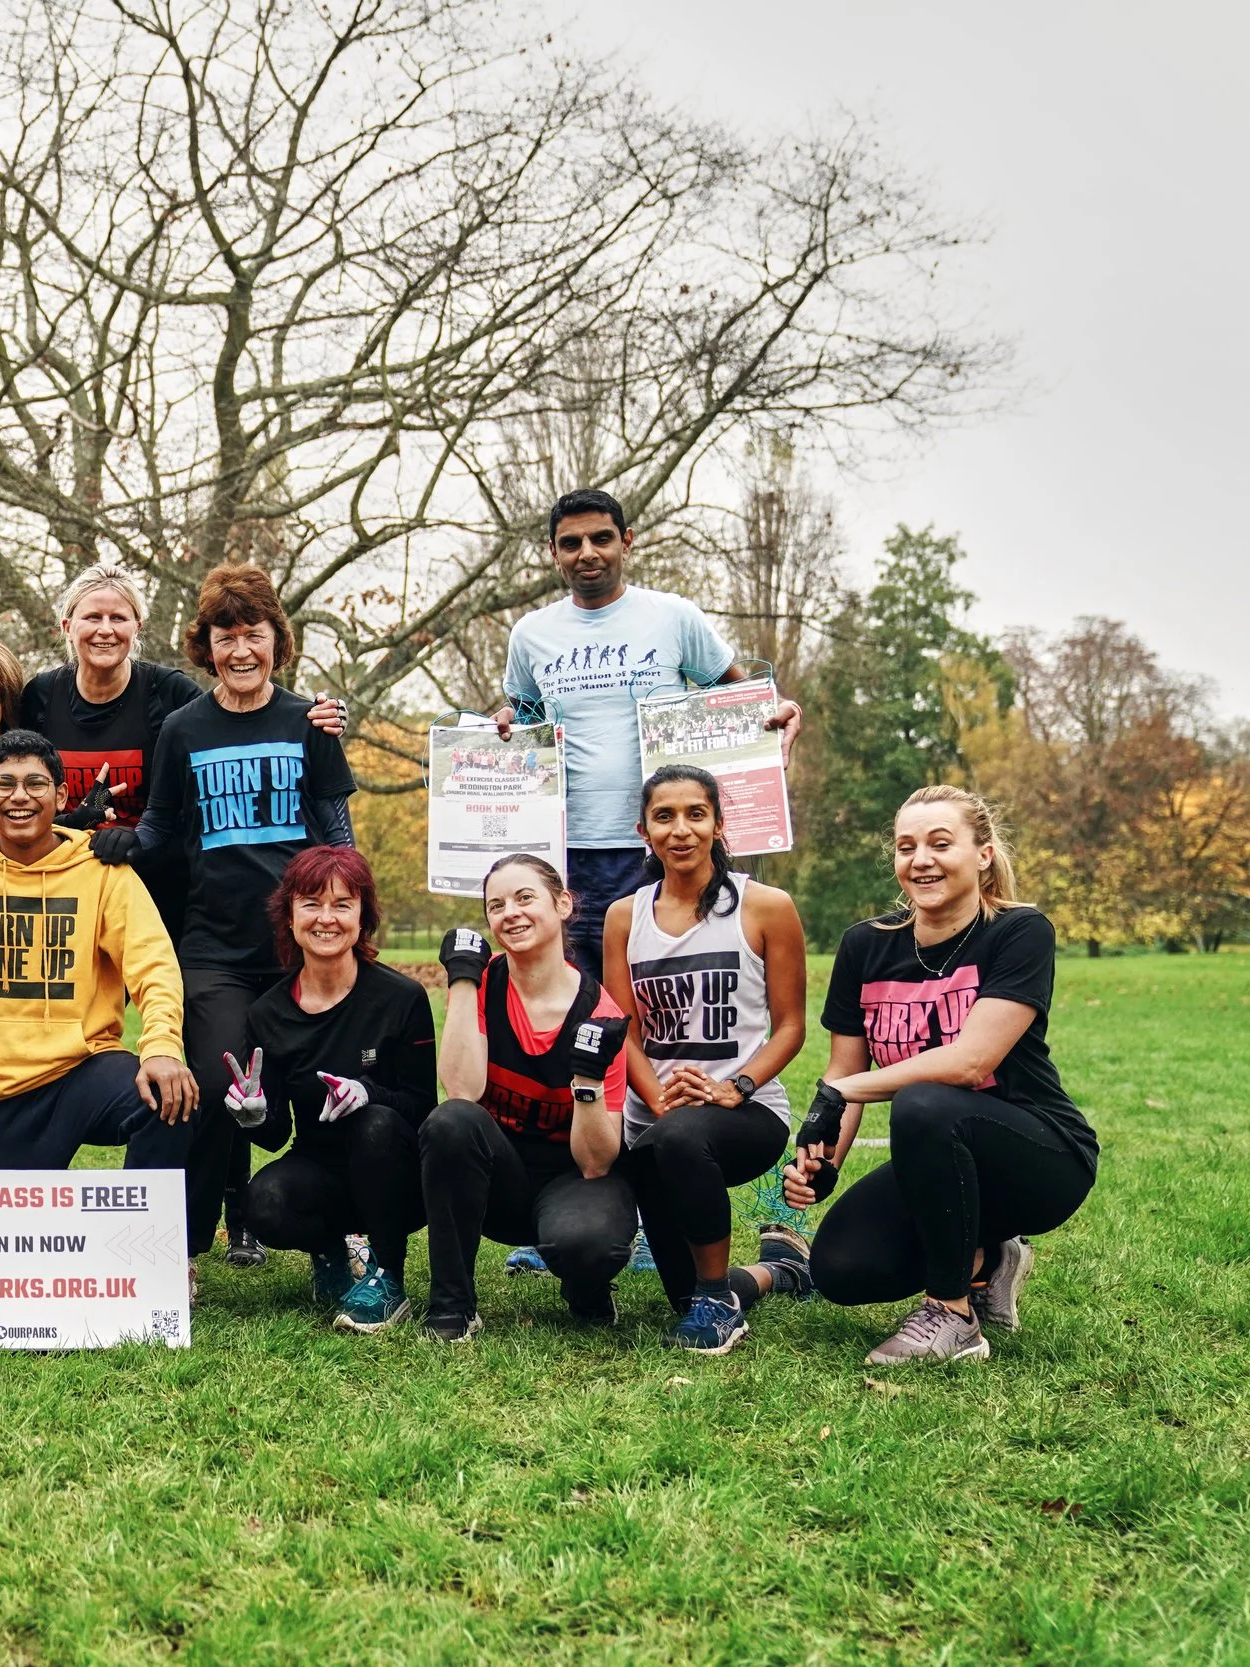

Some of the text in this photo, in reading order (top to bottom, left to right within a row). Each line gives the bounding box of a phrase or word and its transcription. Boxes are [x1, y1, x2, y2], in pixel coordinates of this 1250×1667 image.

[557, 671, 612, 684] Evolution
[630, 669, 661, 679] Sport
[557, 685, 576, 694] The
[579, 681, 616, 690] Manor
[619, 679, 654, 687] House
[707, 735, 729, 750] FOR
[730, 731, 759, 747] FREE
[110, 767, 143, 797] UP
[192, 757, 303, 800] TURN UP
[459, 783, 522, 791] BEDDINGTON PARK
[198, 790, 302, 833] TONE UP
[466, 804, 520, 813] BOOK NOW
[41, 915, 75, 948] UP
[41, 949, 75, 981] UP
[634, 971, 738, 1011] TURN UP
[644, 1006, 738, 1042] TONE UP
[860, 988, 978, 1042] TURN UP
[52, 1187, 74, 1208] IS
[81, 1186, 148, 1208] FREE!
[15, 1236, 34, 1252] IN
[40, 1236, 86, 1252] NOW
[8, 1327, 58, 1339] OURPARKS
